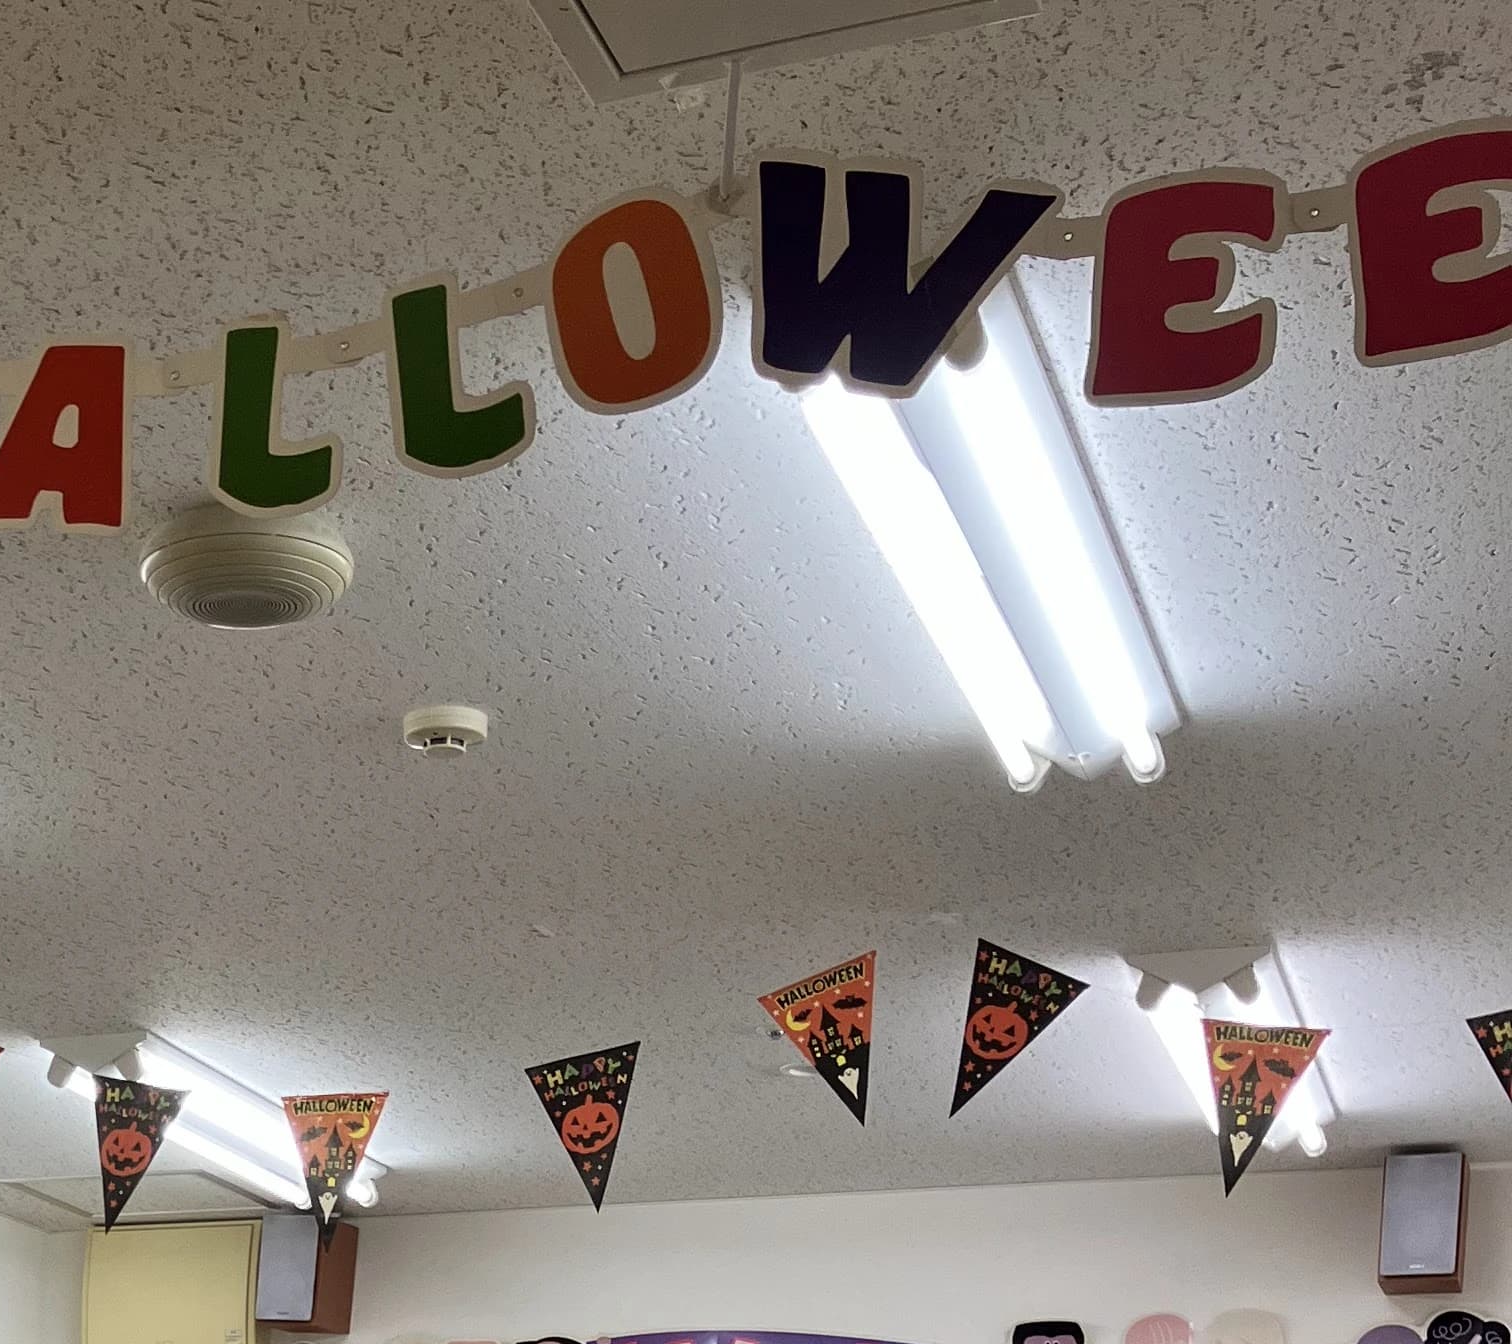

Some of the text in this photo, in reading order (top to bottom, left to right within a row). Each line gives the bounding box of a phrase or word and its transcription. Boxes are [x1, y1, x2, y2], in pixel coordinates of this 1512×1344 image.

[775, 962, 865, 1010] HALLOWEEN
[989, 955, 1062, 997] HAPPY
[1215, 1025, 1315, 1049] HALLOWEEN
[546, 1057, 621, 1088] HAPPY
[291, 1098, 374, 1116] HALLOWEEN
